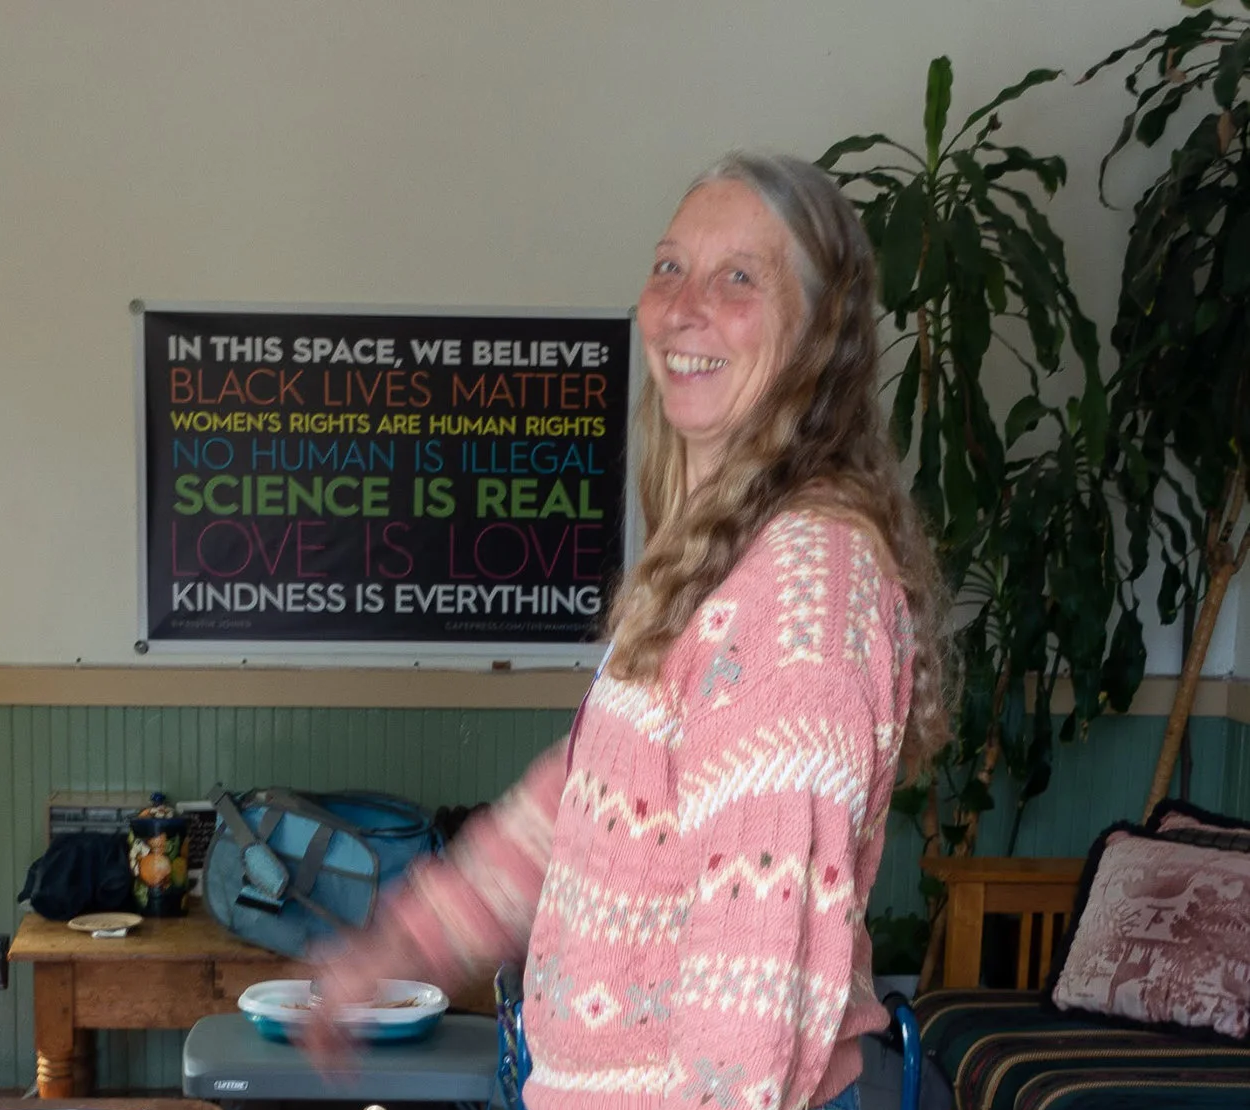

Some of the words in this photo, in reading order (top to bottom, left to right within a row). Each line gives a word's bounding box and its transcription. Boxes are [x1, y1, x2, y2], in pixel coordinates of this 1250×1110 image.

[167, 334, 202, 361] IN
[209, 335, 284, 362] THIS
[292, 337, 404, 368] SPACE,
[410, 339, 462, 366] WE
[472, 341, 610, 367] BELIEVE:
[170, 366, 306, 405] BLACK
[323, 369, 432, 408] LIVES
[452, 372, 608, 409] MATTER
[170, 410, 282, 433] WOMEN'S
[289, 412, 371, 434] RIGHTS
[376, 413, 421, 434] ARE
[429, 415, 517, 436] HUMAN
[525, 416, 606, 437] RIGHTS
[172, 436, 234, 470] NO
[252, 438, 395, 472] HUMAN
[415, 439, 444, 473] IS
[462, 441, 605, 475] ILLEGAL
[172, 474, 390, 517] SCIENCE
[413, 477, 457, 518] IS
[476, 478, 604, 519] REAL
[171, 519, 329, 578] LOVE
[365, 521, 414, 579] IS
[449, 523, 603, 581] LOVE
[172, 581, 346, 613] KINDNESS
[355, 582, 385, 613] IS
[395, 584, 602, 616] EVERYTHING
